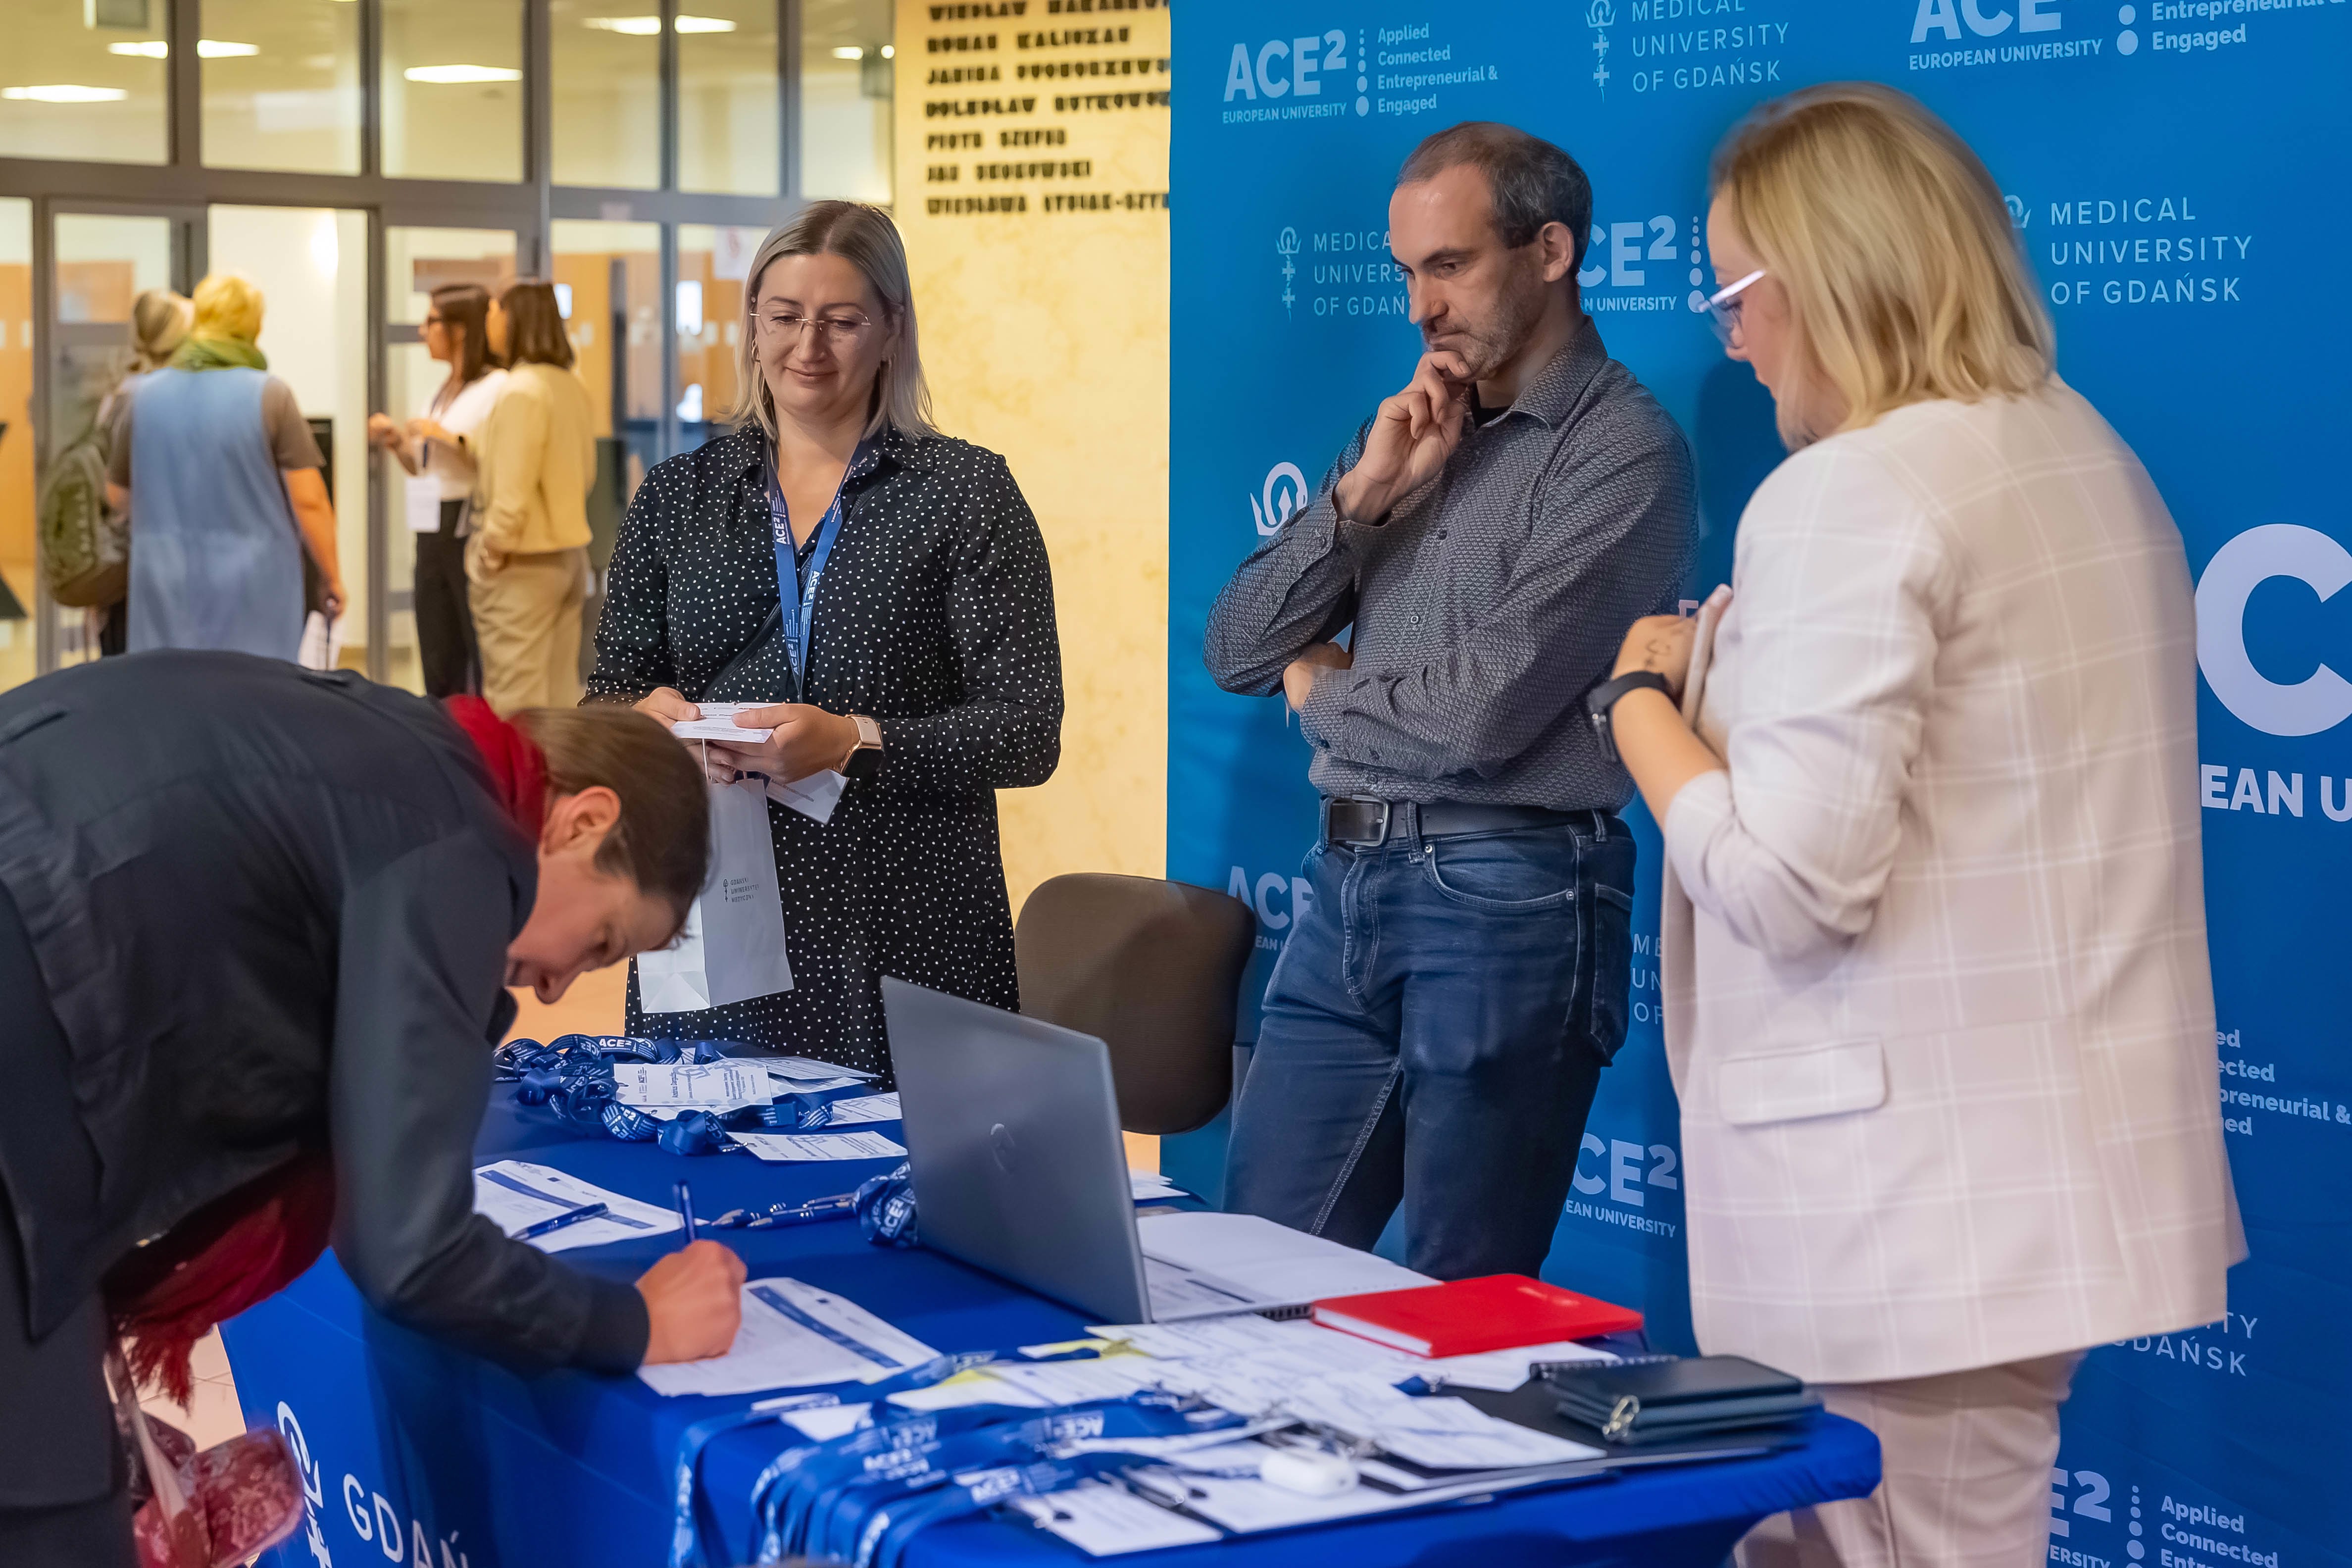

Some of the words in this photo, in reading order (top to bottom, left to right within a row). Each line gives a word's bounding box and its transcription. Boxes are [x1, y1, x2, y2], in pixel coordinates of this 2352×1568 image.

[2152, 0, 2325, 21] Entrepreneur
[1378, 23, 1429, 46] Applied
[1632, 22, 1789, 57] UNIVERSITY
[2152, 23, 2246, 53] Engaged
[1378, 46, 1451, 66] Connected
[1909, 49, 1996, 70] EUROPEAN
[2001, 38, 2103, 62] UNIVERSITY
[1378, 67, 1486, 91] Entrepreneurial
[1489, 65, 1498, 81] &
[1633, 70, 1664, 93] OF
[1674, 57, 1780, 89] GDAŃSK
[1223, 108, 1279, 124] EUROPEAN
[1282, 102, 1347, 120] UNIVERSITY
[1378, 94, 1437, 114] Engaged
[2050, 197, 2196, 226] MEDICAL
[1314, 230, 1391, 252] MEDICA
[2051, 235, 2252, 265] UNIVERSITY
[2051, 281, 2091, 305] OF
[2103, 272, 2241, 303] GDAŃSK
[1313, 297, 1339, 316] OF
[1597, 296, 1677, 311] UNIVERSITY
[2195, 523, 2352, 737] C
[2201, 763, 2303, 818] EAN
[2320, 775, 2352, 822] U
[1255, 935, 1278, 951] EAN
[1634, 1002, 1662, 1025] OF
[2217, 1029, 2241, 1048] ed
[2221, 1116, 2253, 1136] ed
[2336, 1105, 2352, 1125] &
[1565, 1199, 1592, 1218] EAN
[1595, 1207, 1676, 1238] UNIVERSITY
[2112, 1335, 2246, 1376] DAŃSK
[2160, 1495, 2245, 1534] Applied
[2161, 1523, 2278, 1568] Connected
[2160, 1549, 2214, 1568] Entr
